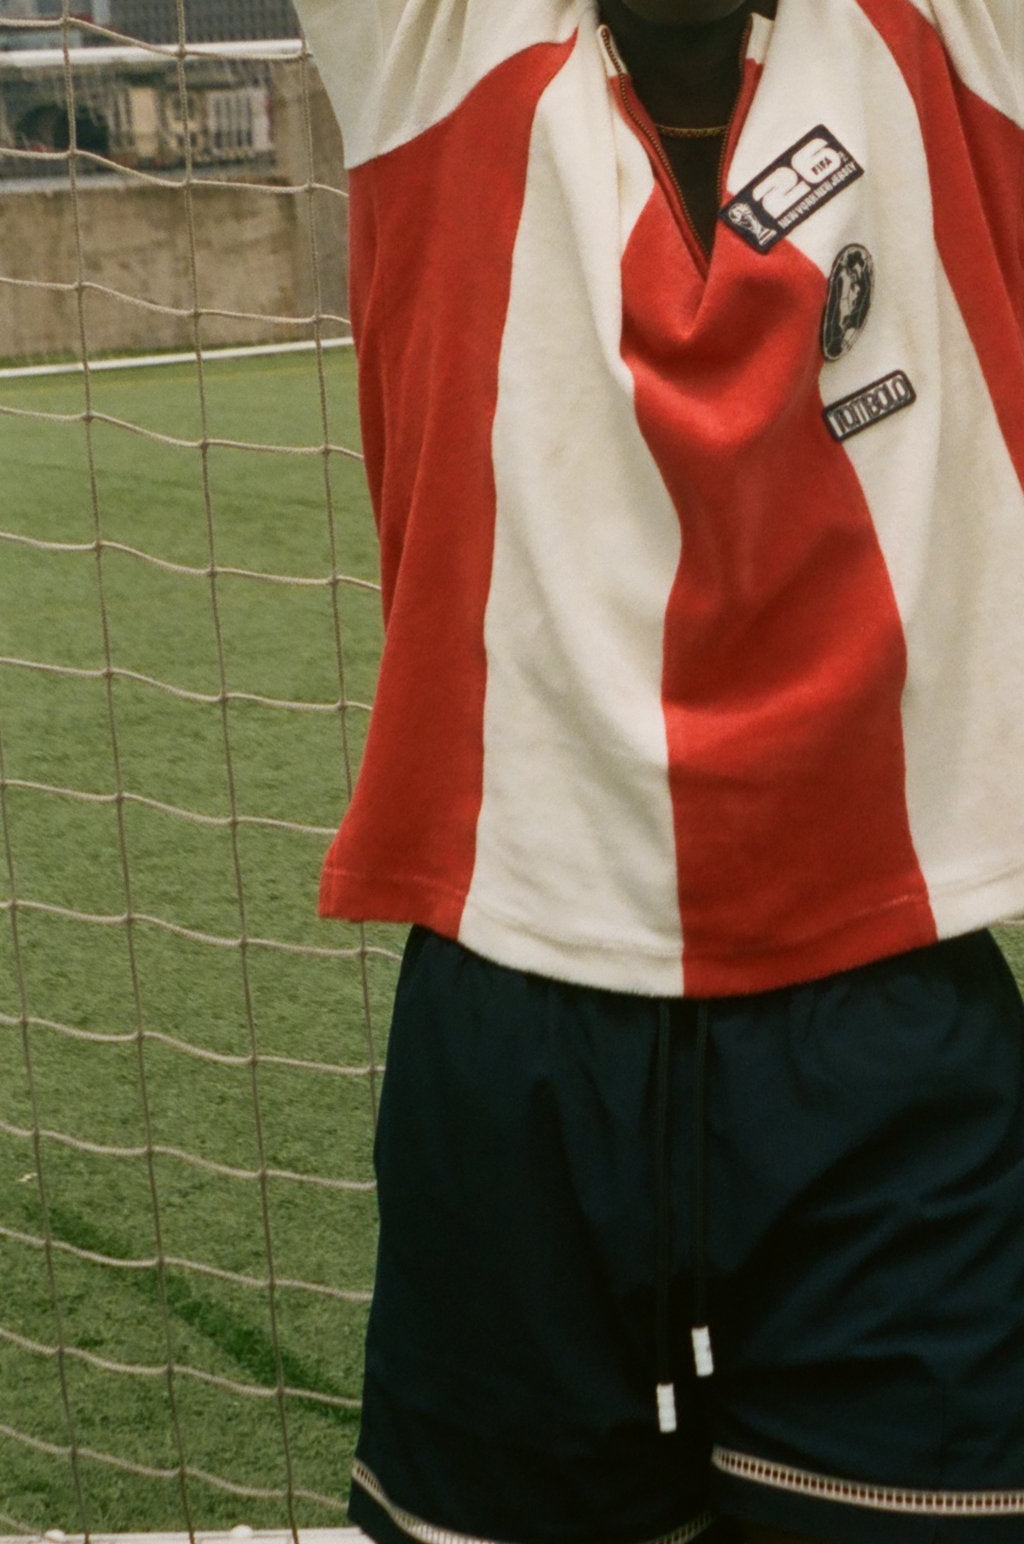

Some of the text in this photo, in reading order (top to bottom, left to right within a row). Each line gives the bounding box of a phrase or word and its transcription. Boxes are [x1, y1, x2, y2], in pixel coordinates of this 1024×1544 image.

[752, 138, 841, 219] 26
[777, 161, 856, 229] NEW YORK NEW JERSEY
[811, 156, 832, 176] FIFA
